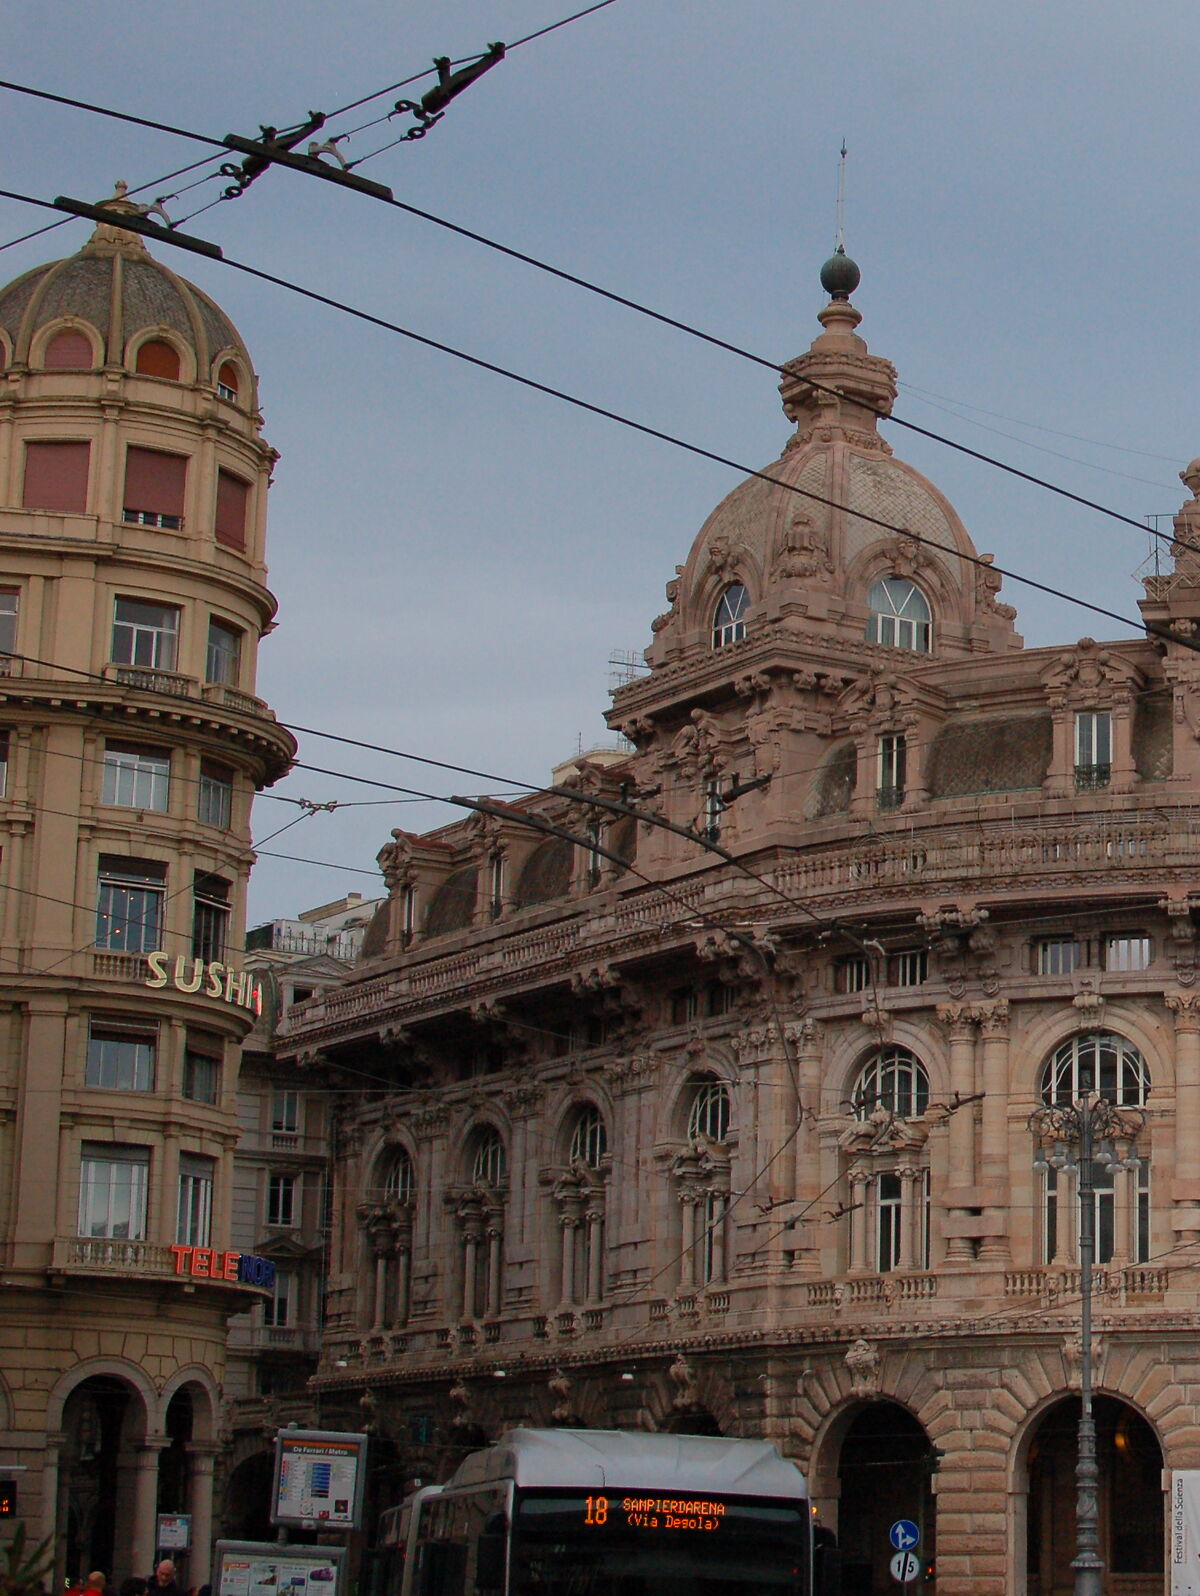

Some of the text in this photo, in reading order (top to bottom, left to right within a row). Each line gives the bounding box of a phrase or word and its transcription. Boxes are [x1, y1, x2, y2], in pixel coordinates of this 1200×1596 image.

[144, 951, 253, 1009] SUSHI
[584, 1496, 609, 1526] 18
[623, 1497, 726, 1516] SAMPIERDARENA
[627, 1513, 659, 1529] (Via
[1174, 1478, 1183, 1565] Festival della Scienza
